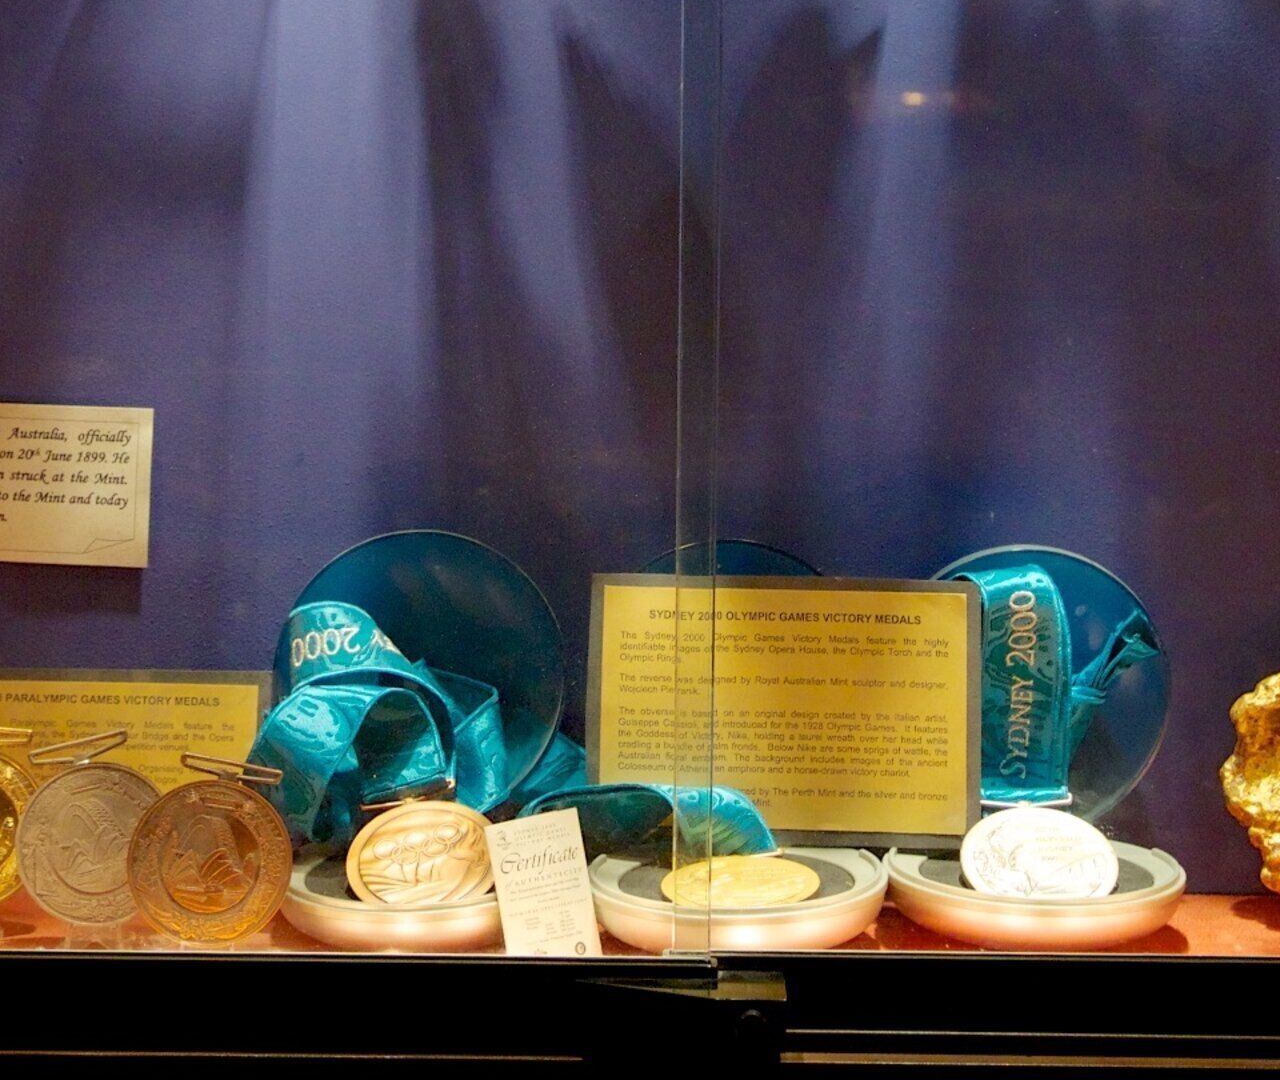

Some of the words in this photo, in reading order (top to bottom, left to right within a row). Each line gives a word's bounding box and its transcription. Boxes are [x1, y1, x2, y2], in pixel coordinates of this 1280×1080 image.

[7, 425, 68, 442] Australia,
[76, 428, 131, 447] officially
[42, 449, 73, 464] June
[76, 450, 107, 463] 1899.
[111, 451, 130, 464] He
[9, 467, 49, 485] struck
[50, 472, 65, 482] at
[69, 469, 89, 483] the
[93, 472, 127, 485] Mint.
[11, 488, 31, 502] the
[33, 491, 66, 504] Mint
[68, 491, 94, 505] and
[94, 491, 129, 510] today
[725, 610, 776, 622] OLYMPIC
[778, 611, 820, 623] GAMES
[822, 612, 872, 624] VICTORY
[874, 613, 921, 624] MEDALS
[1005, 589, 1038, 668] 2000
[291, 626, 361, 668] 2000
[4, 692, 78, 704] PARALYMPIC
[79, 694, 121, 705] GAMES
[123, 695, 172, 706] VICTORY
[173, 696, 220, 707] MEDALS
[999, 675, 1035, 780] SYDNEY
